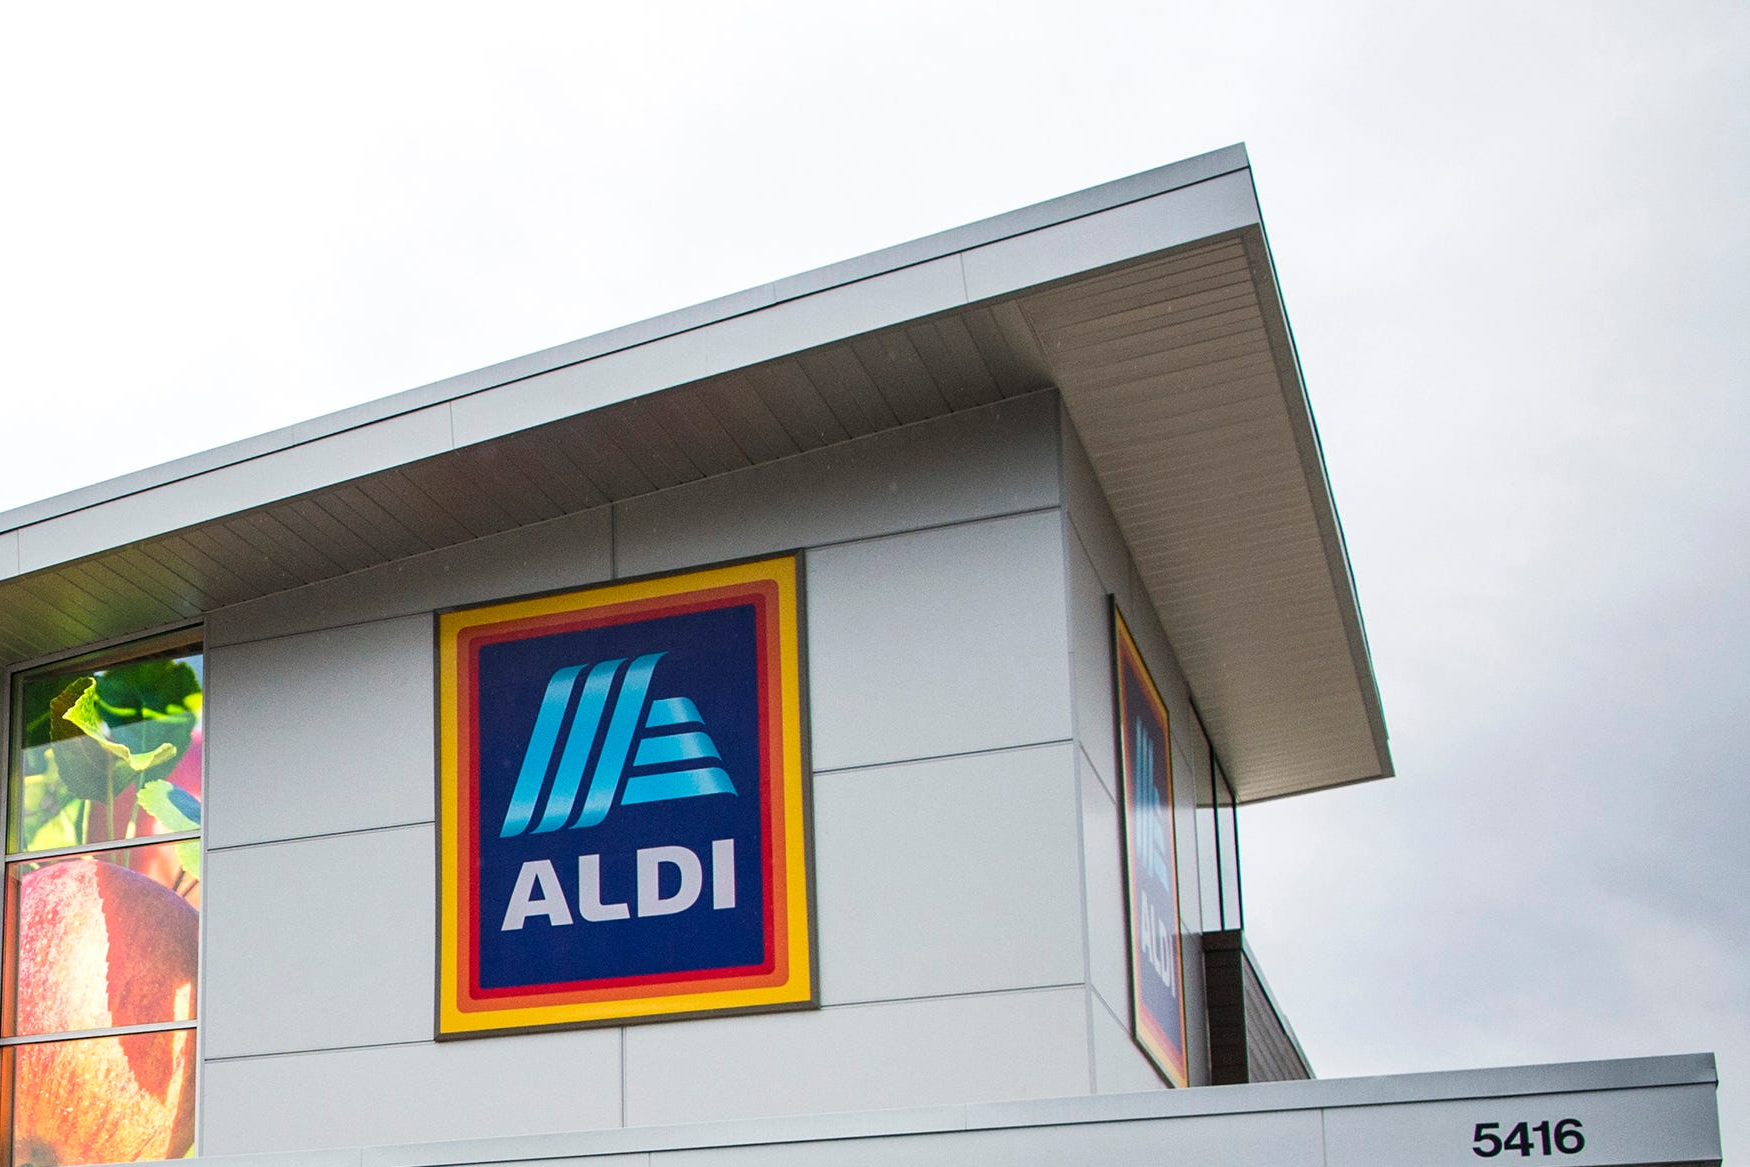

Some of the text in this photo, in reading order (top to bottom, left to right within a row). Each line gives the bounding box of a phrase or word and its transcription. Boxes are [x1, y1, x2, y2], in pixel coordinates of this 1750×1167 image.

[500, 838, 736, 932] ALDI
[1141, 889, 1177, 999] ALDI
[1472, 1118, 1586, 1158] 5416
